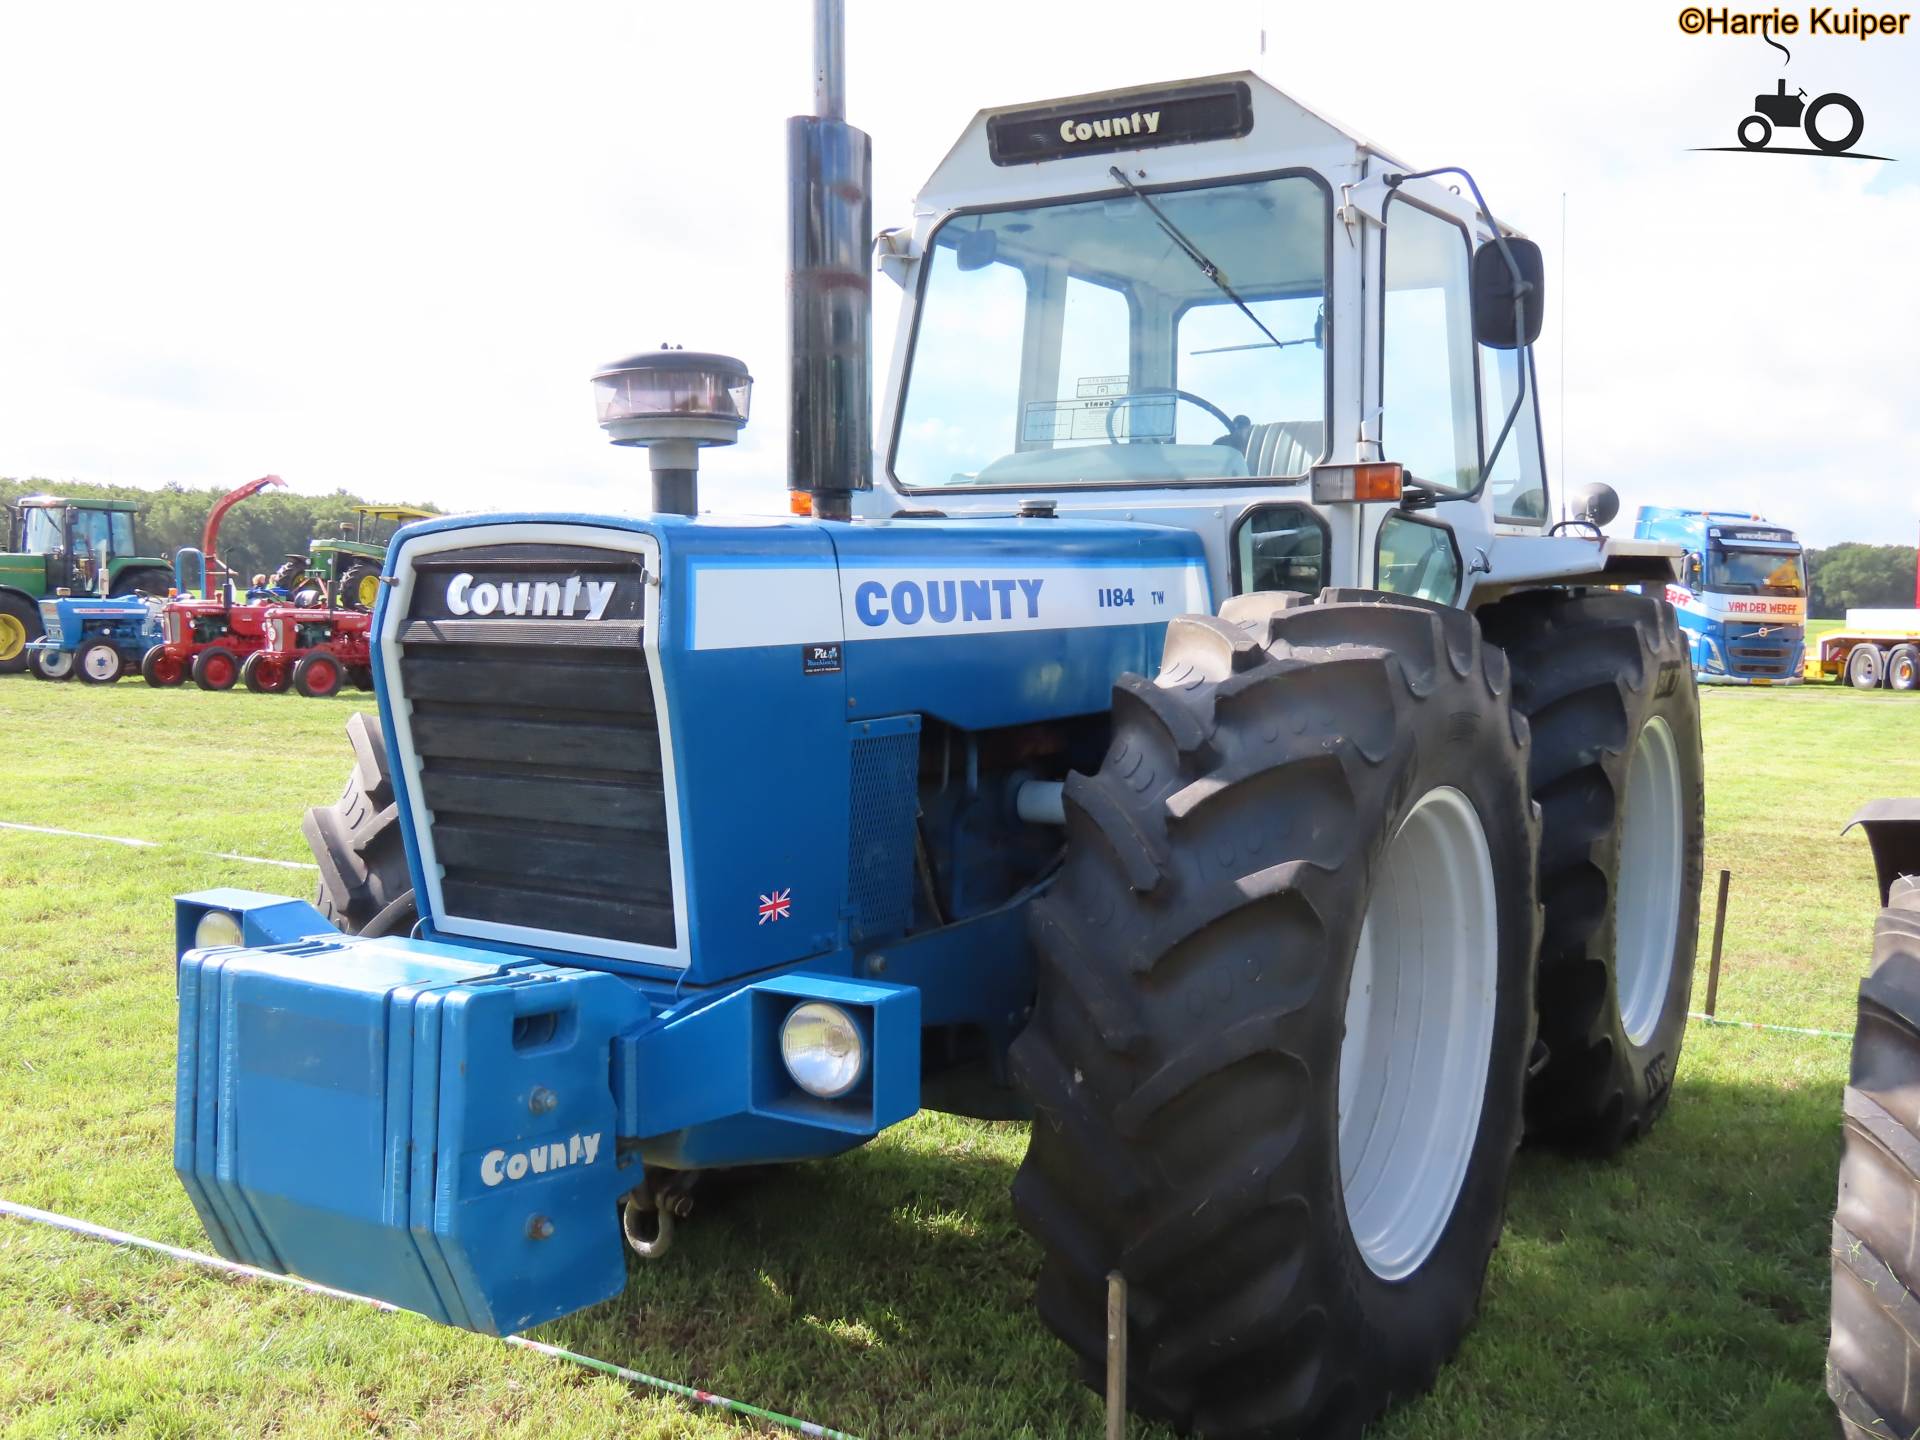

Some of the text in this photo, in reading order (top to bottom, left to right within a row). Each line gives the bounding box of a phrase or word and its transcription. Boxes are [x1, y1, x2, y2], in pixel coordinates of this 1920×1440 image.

[1060, 111, 1160, 142] County
[446, 572, 616, 621] County
[855, 579, 1164, 627] COUNTY 1184 TW
[1665, 588, 1690, 606] ERFF
[1728, 601, 1798, 614] VAN DER WERFF
[814, 647, 828, 659] Pit
[481, 1133, 601, 1186] County
